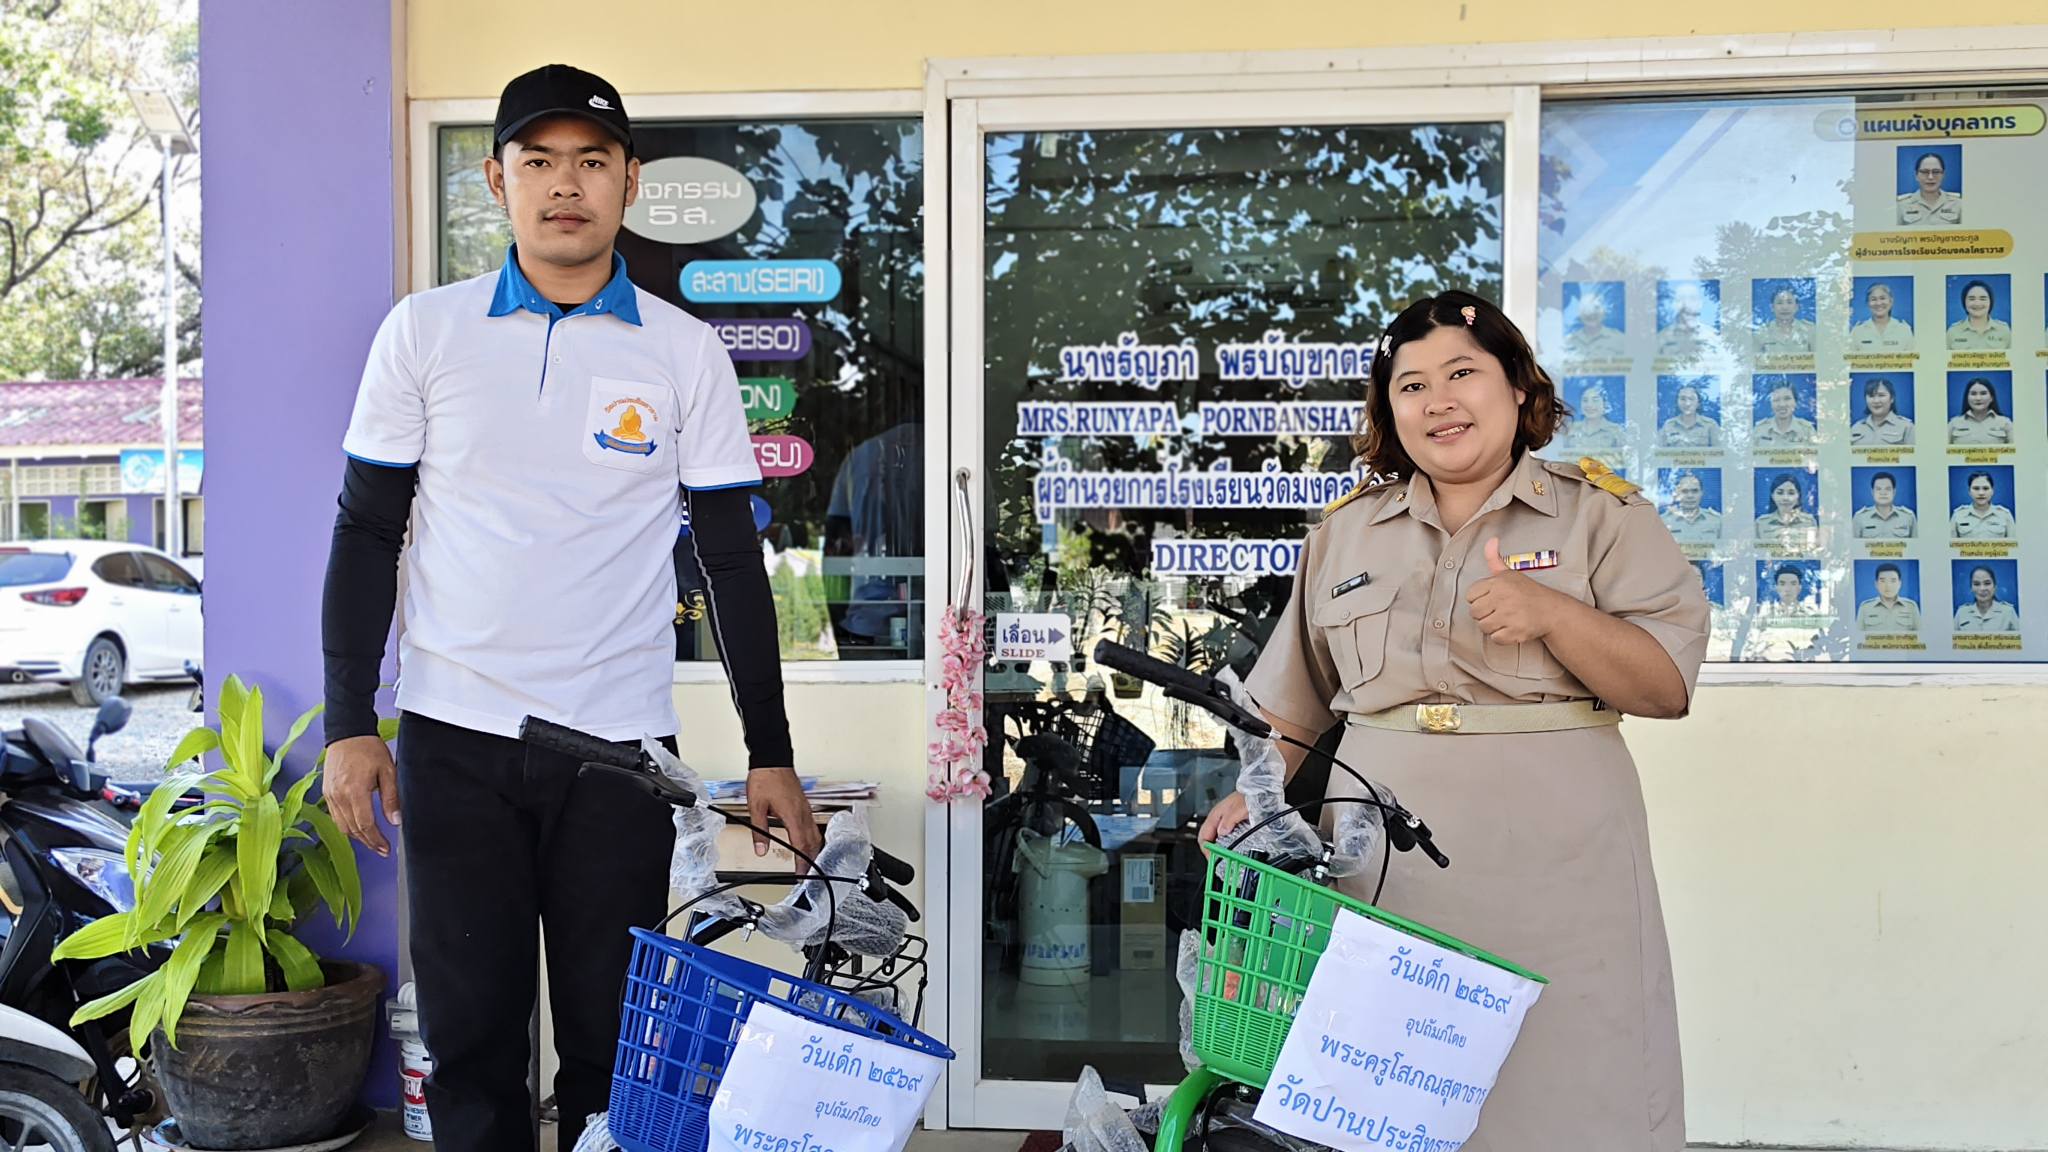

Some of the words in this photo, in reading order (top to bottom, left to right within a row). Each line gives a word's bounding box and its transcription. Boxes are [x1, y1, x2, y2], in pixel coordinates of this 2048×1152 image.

[1863, 113, 2017, 137] แผนผังบุคลากร
[637, 178, 742, 200] จกรรม
[1021, 406, 1178, 433] MRS.RUNYAPA
[1002, 617, 1046, 644] เลื่อน
[1001, 648, 1046, 658] SLIDE
[1389, 946, 1450, 994] วันเด็ก
[1455, 977, 1513, 1014] ๒๕๖๙
[801, 1035, 862, 1078] วันเด็ก
[868, 1061, 924, 1092] ๒๕๖๙
